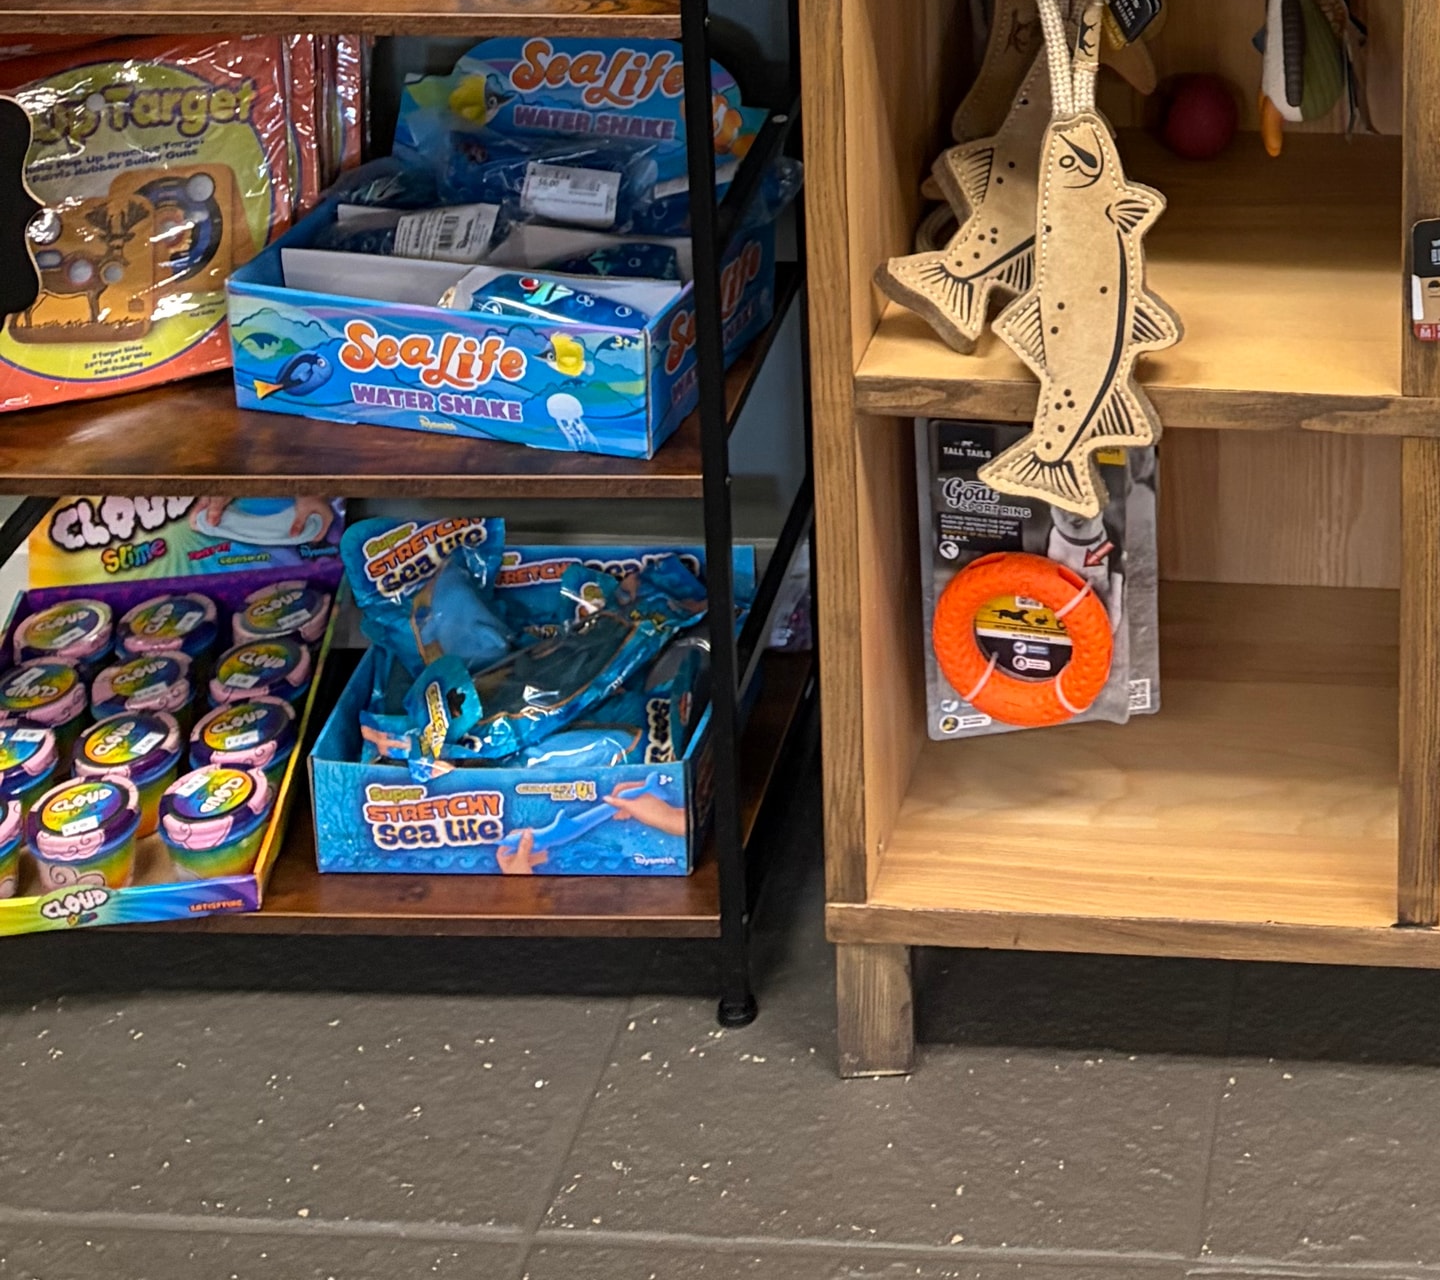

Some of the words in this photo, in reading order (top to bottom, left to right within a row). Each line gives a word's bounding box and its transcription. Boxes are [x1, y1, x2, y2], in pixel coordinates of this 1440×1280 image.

[512, 40, 604, 92] Sea
[583, 49, 684, 109] Life
[101, 78, 257, 138] Target
[514, 105, 591, 131] WATER
[593, 111, 676, 140] SNAKE
[165, 148, 199, 161] Guns
[340, 320, 436, 373] Sea
[419, 331, 527, 389] Life
[352, 384, 437, 412] WATER
[438, 392, 523, 423] SNAKE
[942, 446, 965, 457] TALL
[966, 448, 992, 459] TAILS
[943, 477, 1000, 509] Goat
[960, 501, 1000, 515] SPORT
[1001, 505, 1032, 518] RING
[101, 539, 166, 574] Slime
[252, 591, 304, 616] CLOUD
[239, 652, 287, 669] CLOUD
[211, 709, 269, 734] CLOUD
[49, 788, 113, 813] CLOUD
[200, 776, 245, 814] CLOUD
[366, 794, 501, 823] STRETCHY
[369, 786, 423, 803] Super
[633, 852, 676, 866] Toysmith
[41, 888, 110, 919] CLOUD
